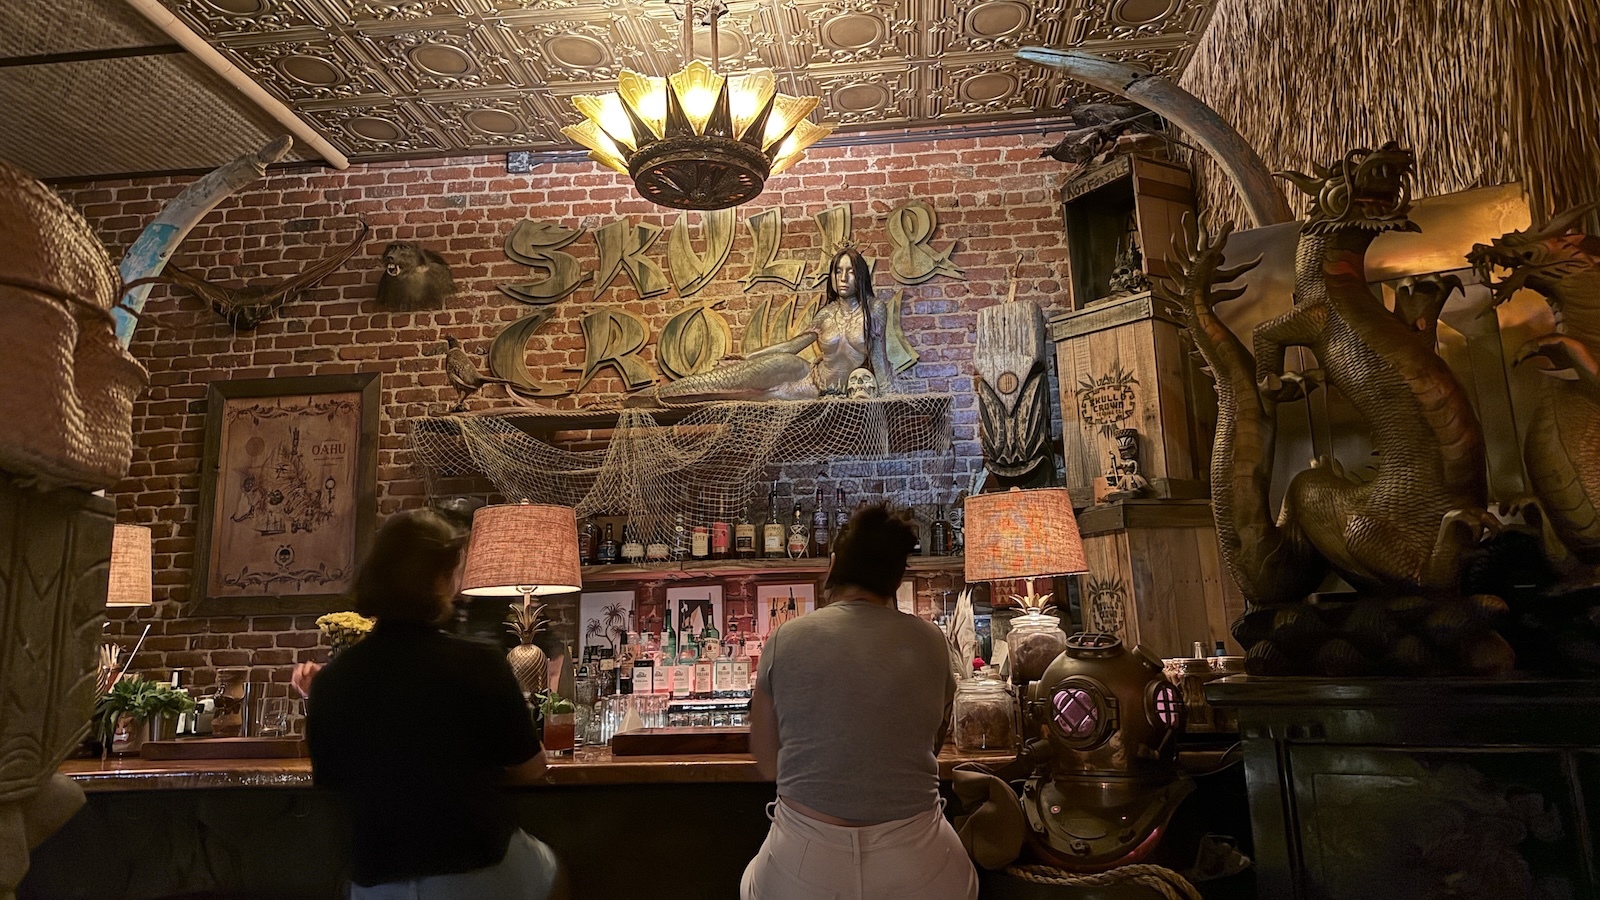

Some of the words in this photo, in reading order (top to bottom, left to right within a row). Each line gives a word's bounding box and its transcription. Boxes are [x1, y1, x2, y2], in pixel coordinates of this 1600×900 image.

[1066, 182, 1087, 200] NOT
[1087, 176, 1105, 191] FOR
[884, 201, 967, 286] &
[488, 290, 921, 396] CROW
[1090, 394, 1118, 407] SKULL
[1093, 402, 1123, 412] CROWN
[312, 443, 346, 455] OAHU
